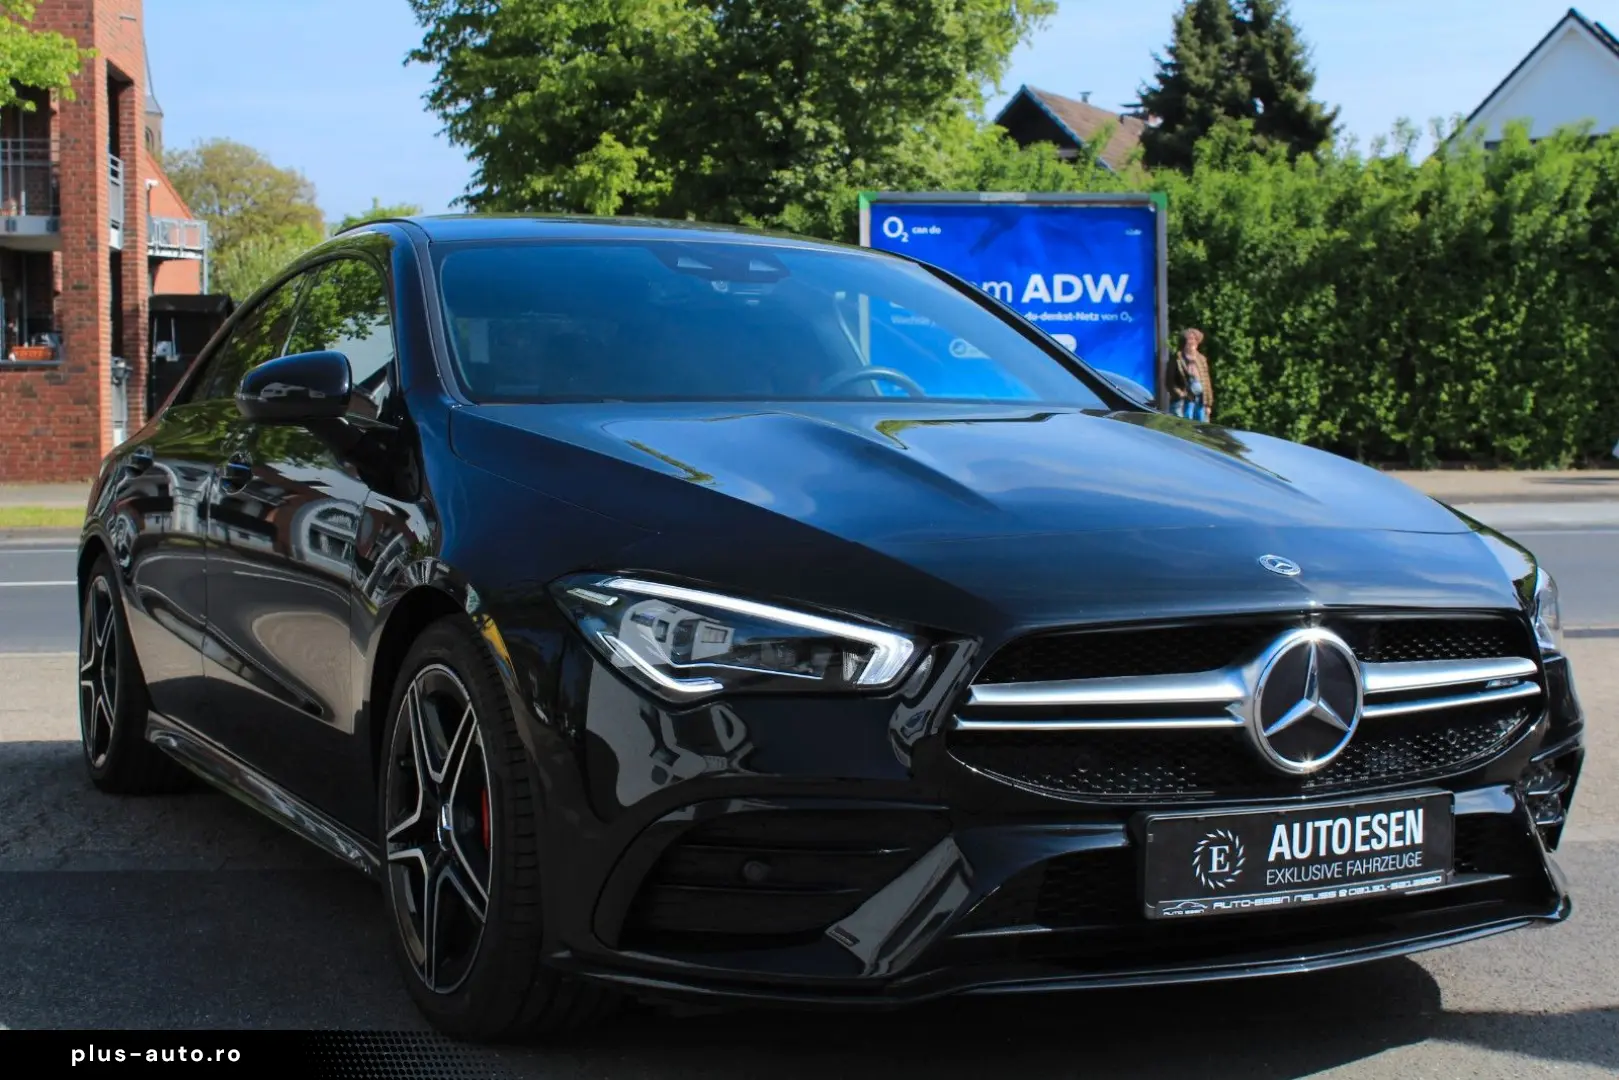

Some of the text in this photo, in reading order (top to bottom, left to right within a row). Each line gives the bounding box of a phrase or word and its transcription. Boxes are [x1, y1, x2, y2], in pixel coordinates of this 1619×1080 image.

[911, 226, 928, 235] can
[929, 225, 942, 235] do
[1020, 273, 1134, 303] ADW.
[1101, 313, 1118, 321] von
[1267, 808, 1424, 862] AUTOESEN
[1266, 861, 1343, 886] EXKLUSIVE
[1346, 851, 1423, 877] FAHRZEUGE
